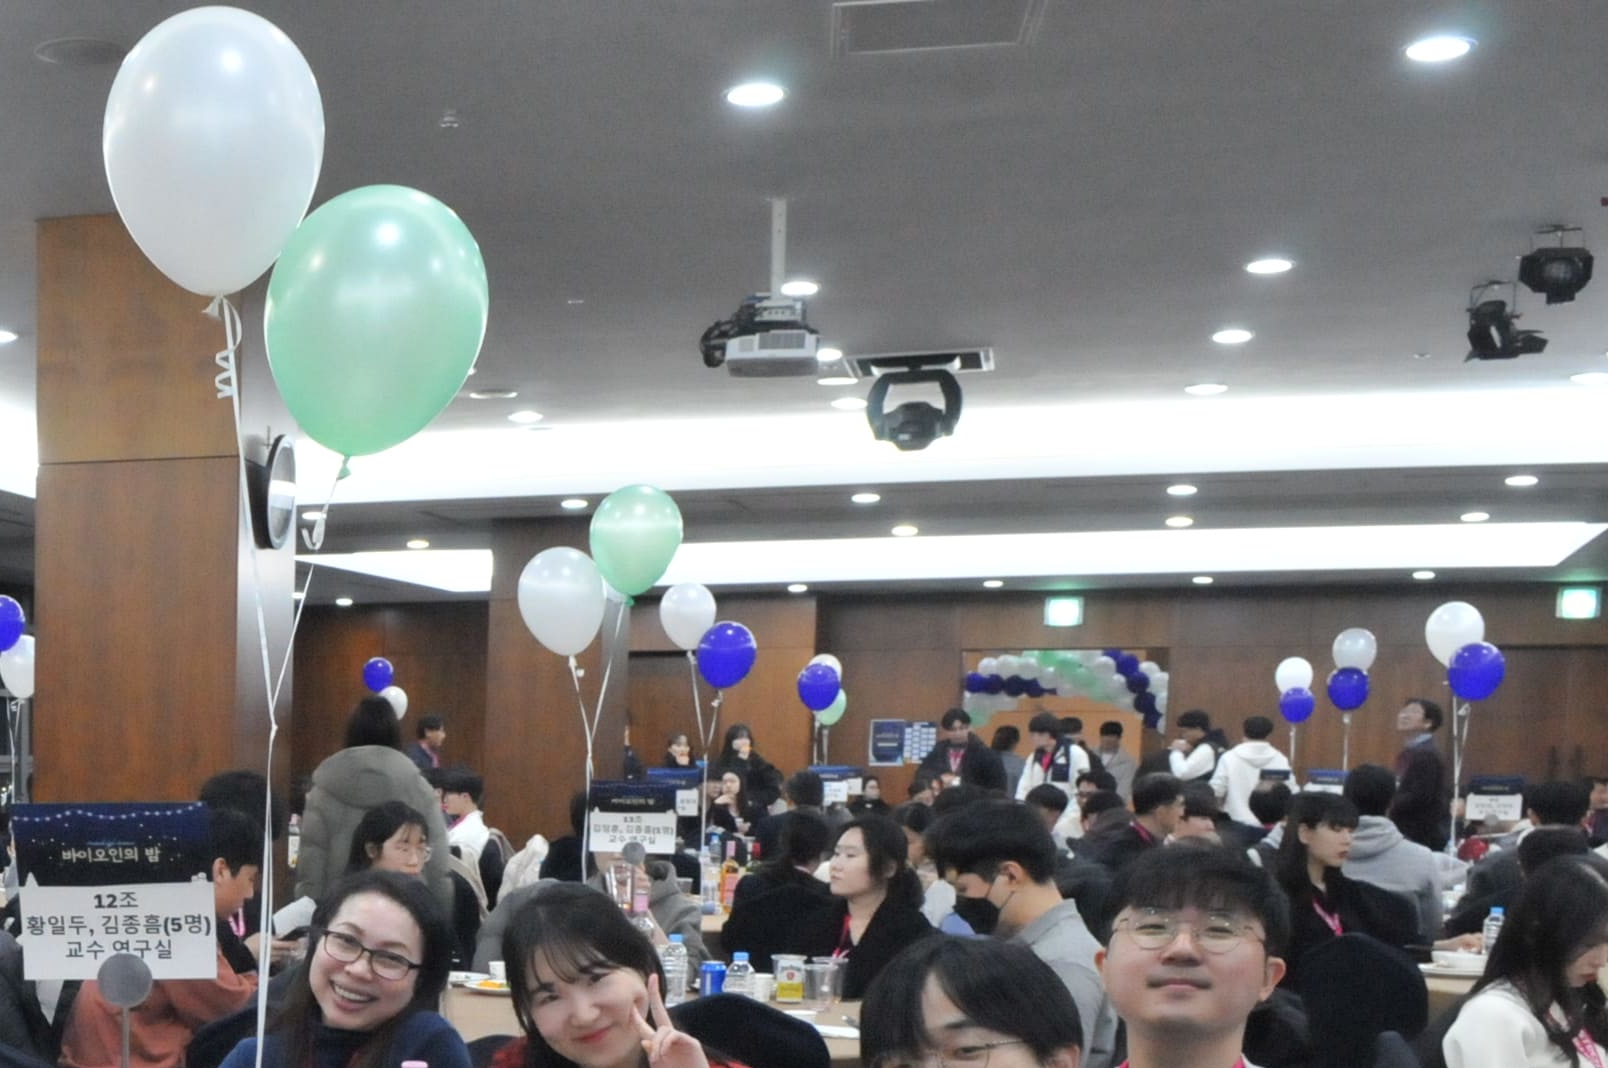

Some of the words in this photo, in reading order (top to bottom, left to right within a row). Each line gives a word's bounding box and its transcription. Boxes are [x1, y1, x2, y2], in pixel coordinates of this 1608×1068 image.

[61, 847, 138, 863] 바이오인의
[144, 846, 161, 863] 밤
[93, 891, 139, 909] 12조
[26, 915, 95, 937] 황일두,
[101, 914, 211, 937] 김종흠(5명)
[65, 940, 105, 960] 교수
